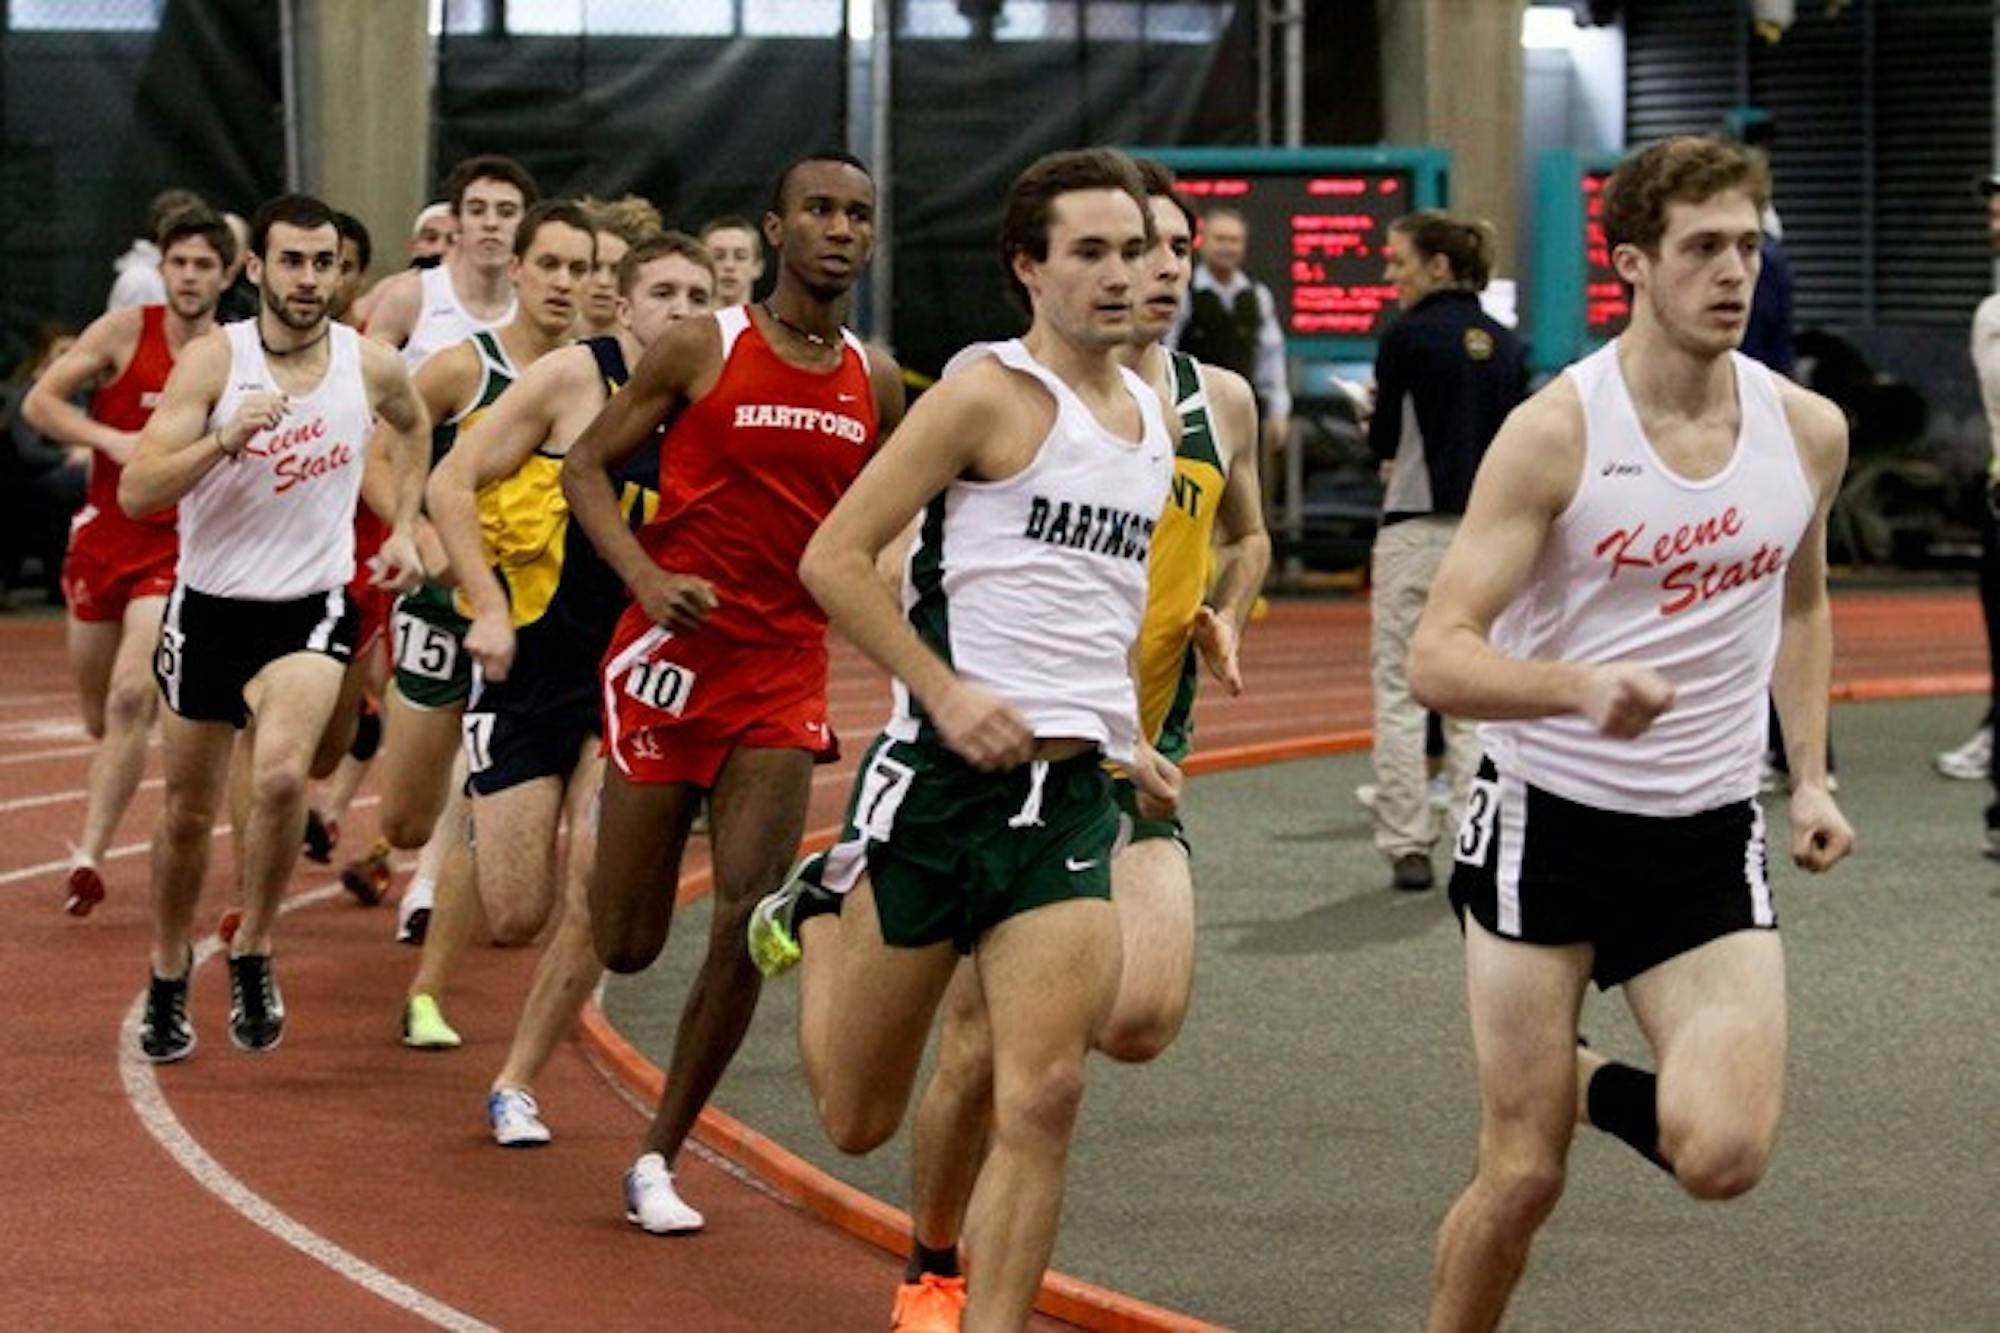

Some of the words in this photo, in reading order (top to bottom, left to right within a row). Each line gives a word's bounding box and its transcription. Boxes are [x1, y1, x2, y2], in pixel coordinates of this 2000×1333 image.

[734, 405, 866, 444] HARTFORD
[274, 446, 350, 493] State
[1595, 507, 1743, 580] Keene
[1660, 544, 1784, 616] State
[401, 621, 447, 672] 15
[636, 663, 682, 708] 10
[866, 764, 902, 825] 7
[1460, 787, 1489, 857] 3
